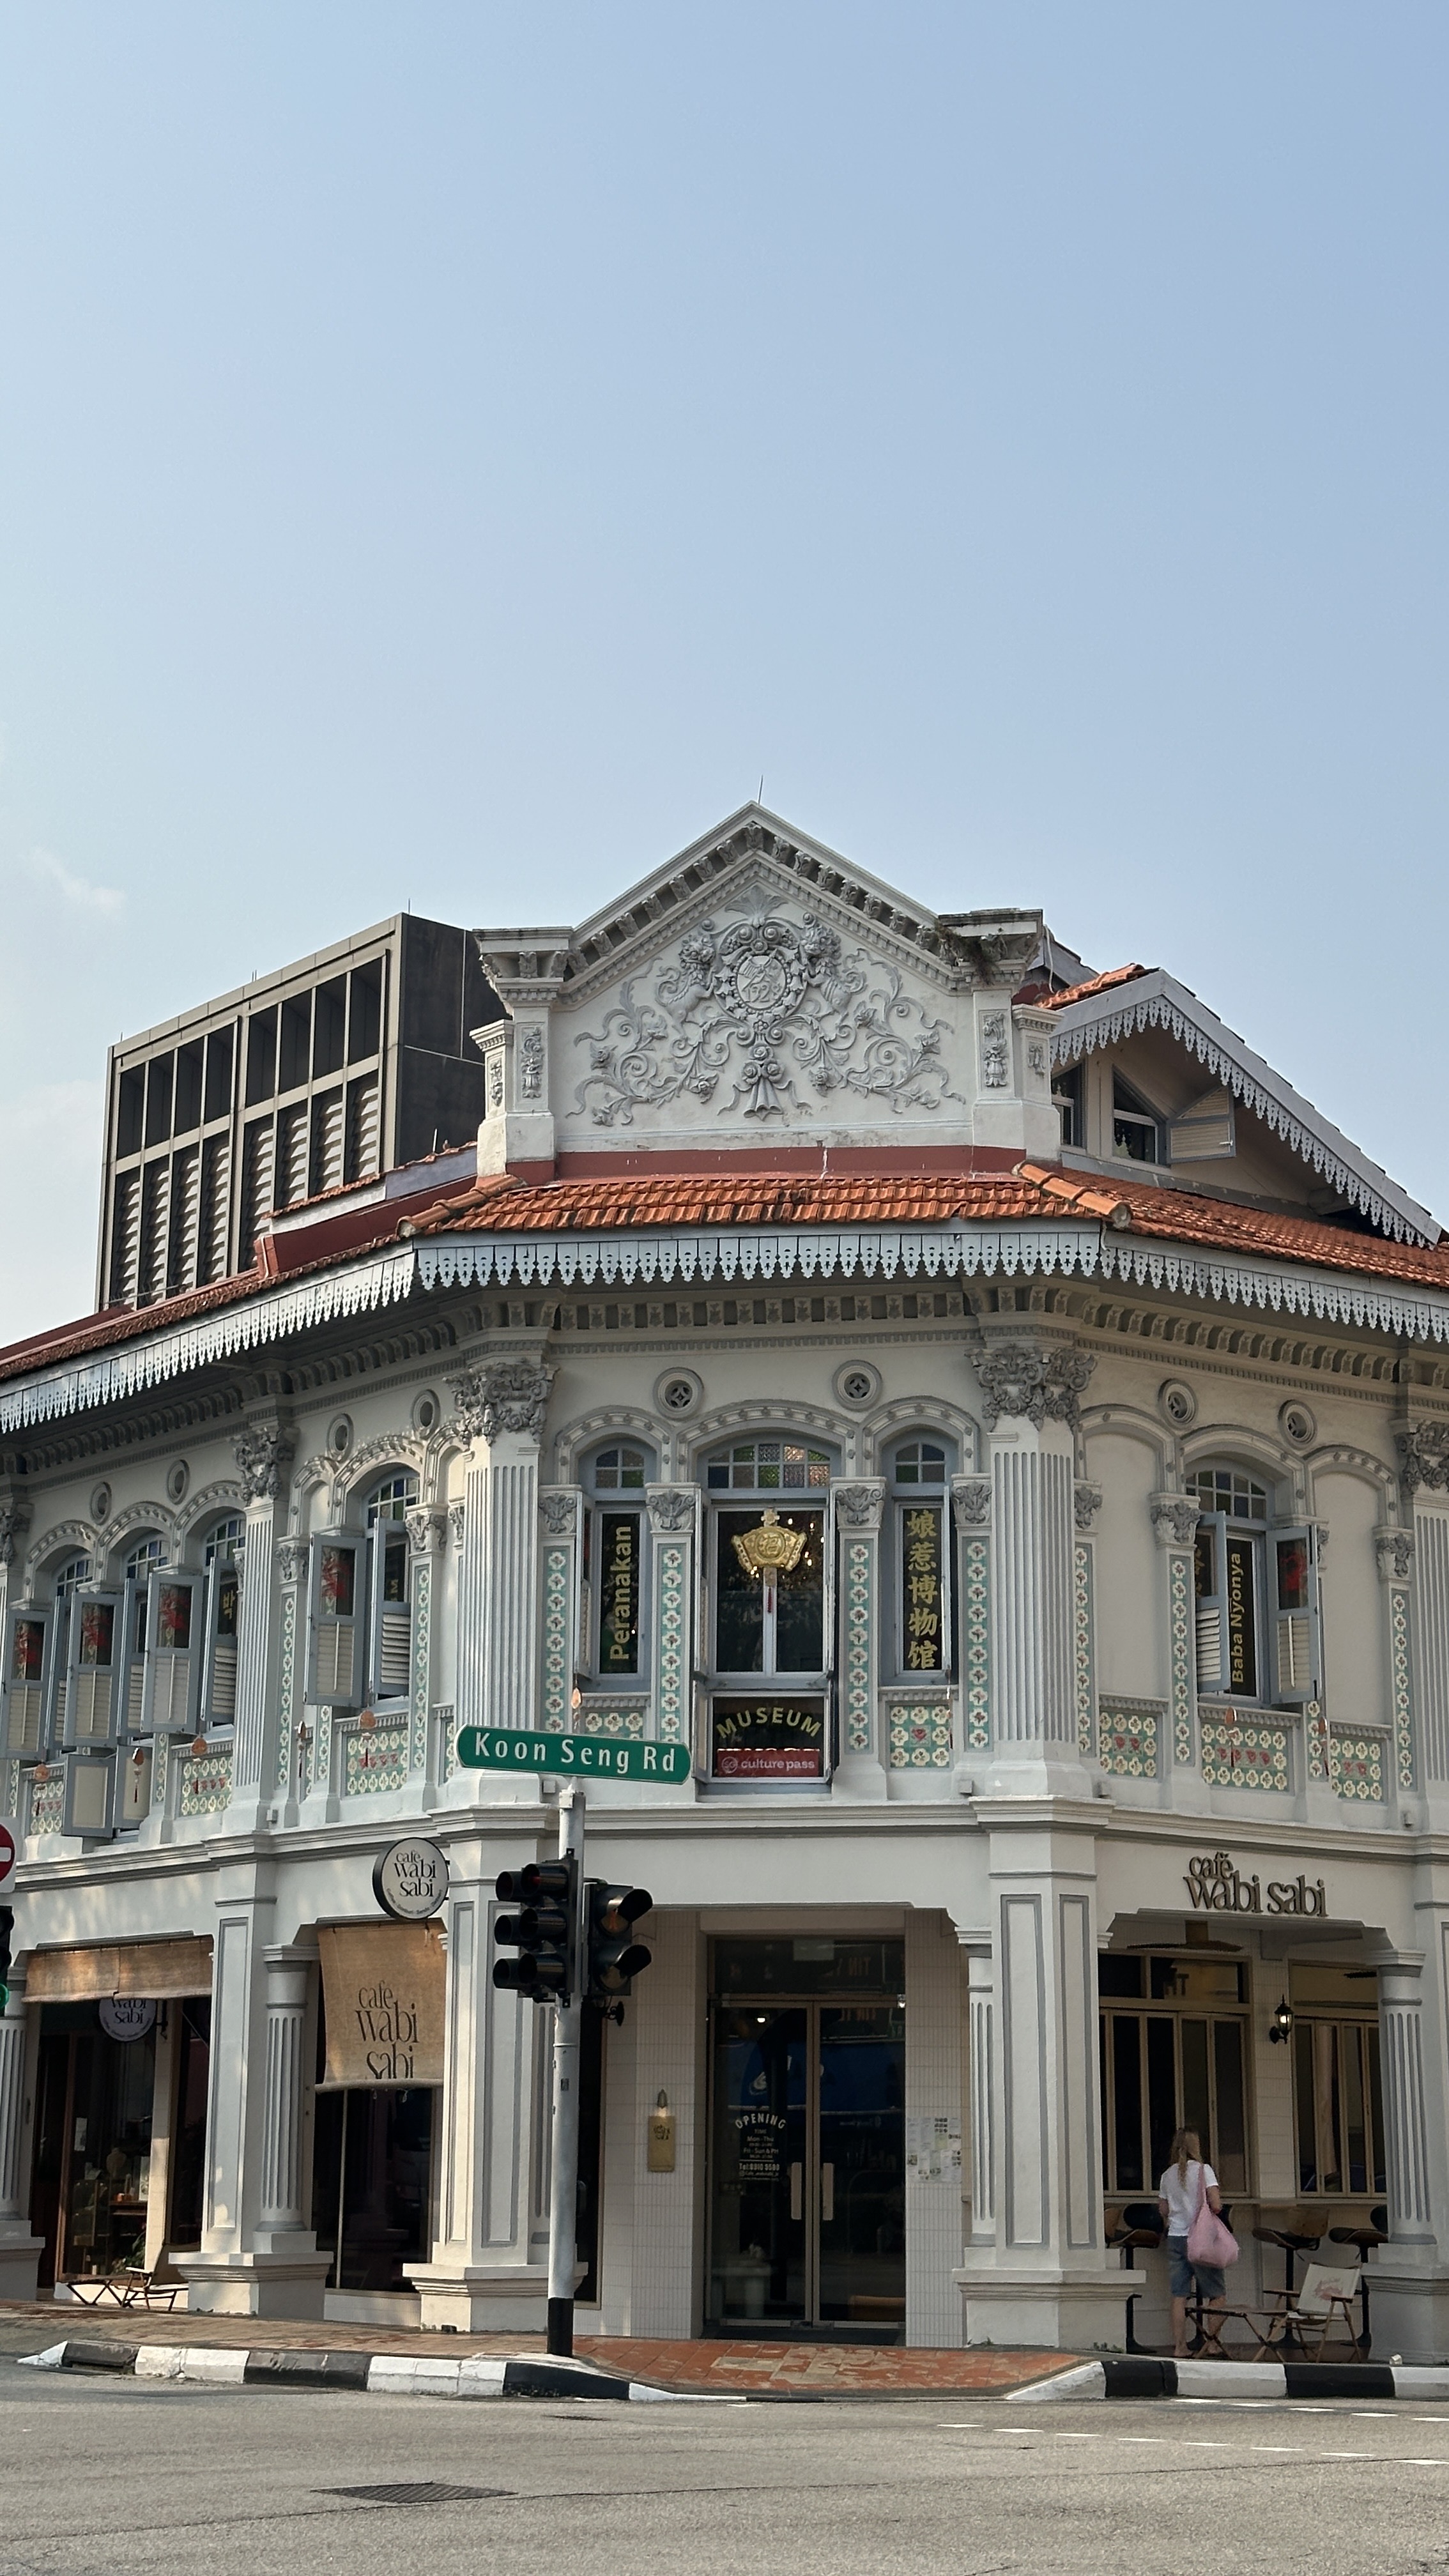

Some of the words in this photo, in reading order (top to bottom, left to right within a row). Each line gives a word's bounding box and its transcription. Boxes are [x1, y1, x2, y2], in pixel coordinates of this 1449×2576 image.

[610, 1526, 631, 1660] Peranakan
[907, 1510, 939, 1669] 娘惹博物馆
[1230, 1552, 1245, 1627] Nyonya
[1231, 1633, 1244, 1683] Baba
[716, 1706, 822, 1738] MUSEUM
[475, 1731, 546, 1761] Koon
[560, 1739, 630, 1774] Seng
[643, 1745, 676, 1772] Rd
[740, 1758, 785, 1770] culture
[786, 1759, 815, 1772] pass
[394, 1859, 437, 1879] wabi
[399, 1878, 434, 1897] sabi
[1183, 1869, 1264, 1913] wabi
[1267, 1874, 1330, 1917] sabi
[114, 2008, 144, 2025] sabi
[355, 2000, 420, 2043] wabi
[735, 2112, 786, 2129] OPENING
